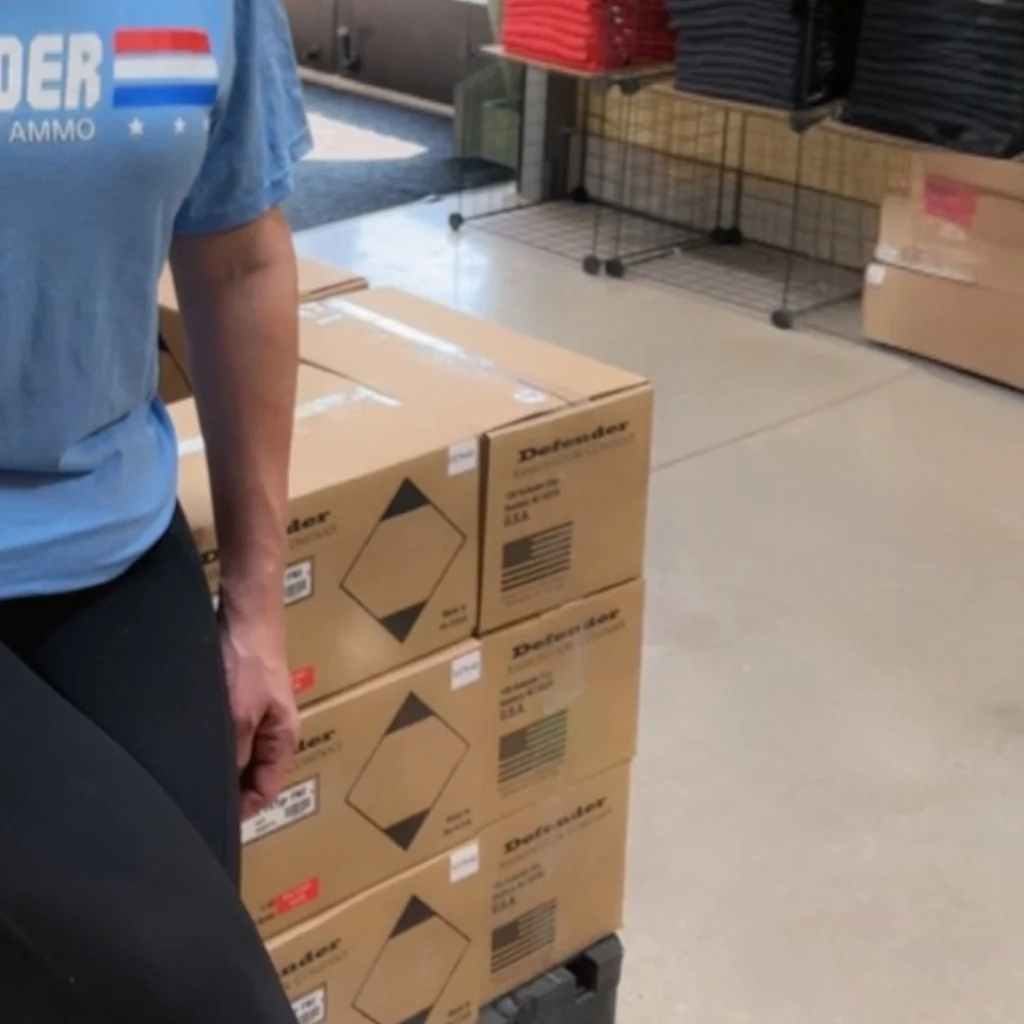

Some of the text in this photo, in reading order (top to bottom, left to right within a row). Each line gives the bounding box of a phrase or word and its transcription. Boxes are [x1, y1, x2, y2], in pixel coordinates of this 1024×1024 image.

[8, 117, 96, 143] AMMO
[517, 421, 630, 464] Defender
[511, 608, 621, 660] Defender
